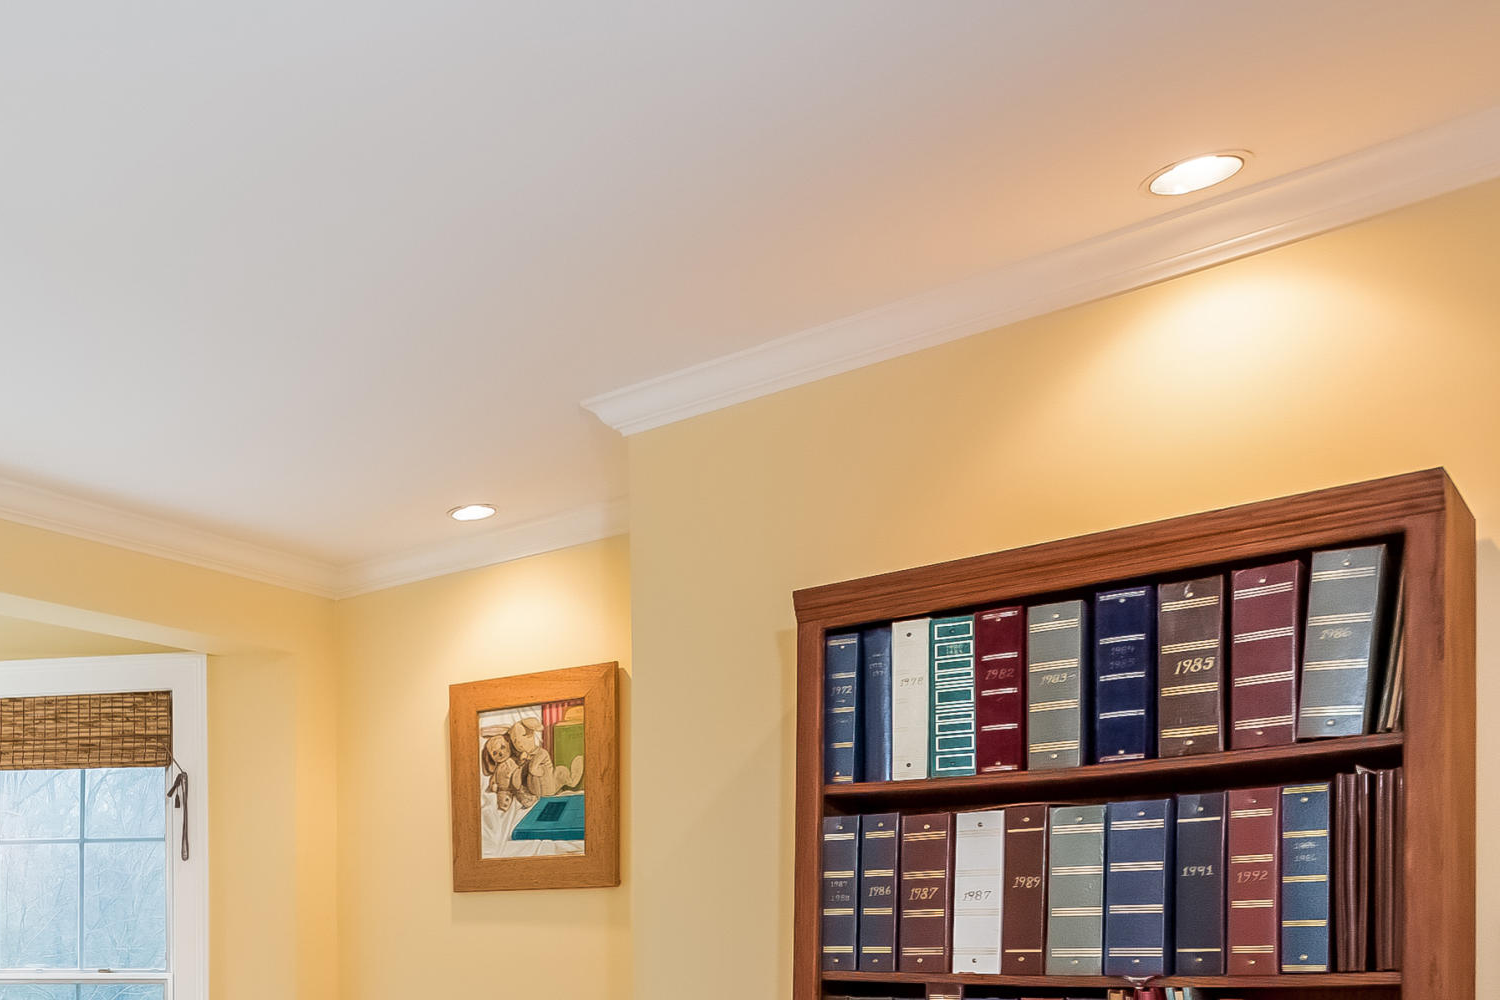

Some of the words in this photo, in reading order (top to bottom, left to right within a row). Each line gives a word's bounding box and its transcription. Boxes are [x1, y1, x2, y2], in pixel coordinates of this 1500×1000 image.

[1174, 656, 1215, 675] 1985
[985, 668, 1015, 680] 1982
[1181, 865, 1214, 877] 1991
[1236, 870, 1269, 883] 1992
[1012, 876, 1042, 889] 1989
[868, 886, 892, 897] 1986
[909, 887, 939, 901] 1987
[963, 890, 992, 901] 1987
